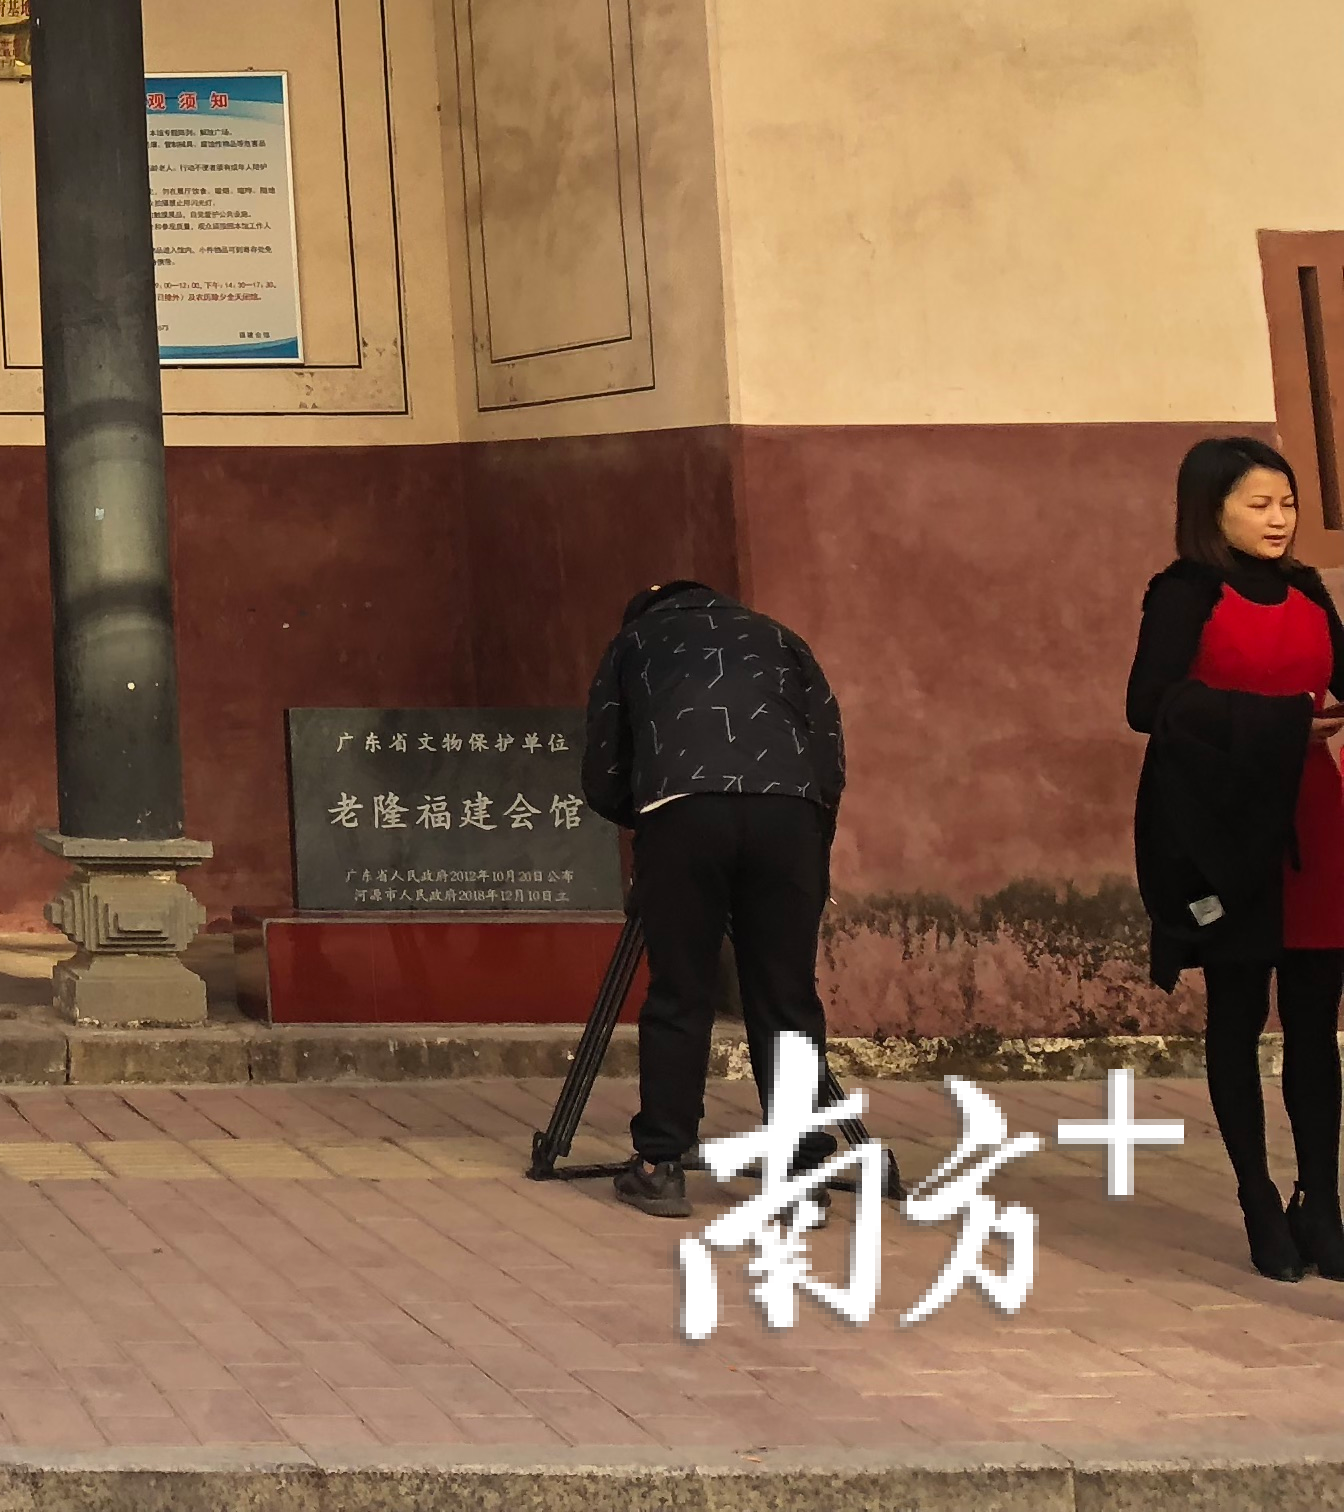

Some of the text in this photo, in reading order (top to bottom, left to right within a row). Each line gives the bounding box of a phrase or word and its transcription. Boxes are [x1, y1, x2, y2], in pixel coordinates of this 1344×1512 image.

[336, 731, 570, 754] 广东省文物保护单位
[327, 791, 585, 831] 老隆福建会馆
